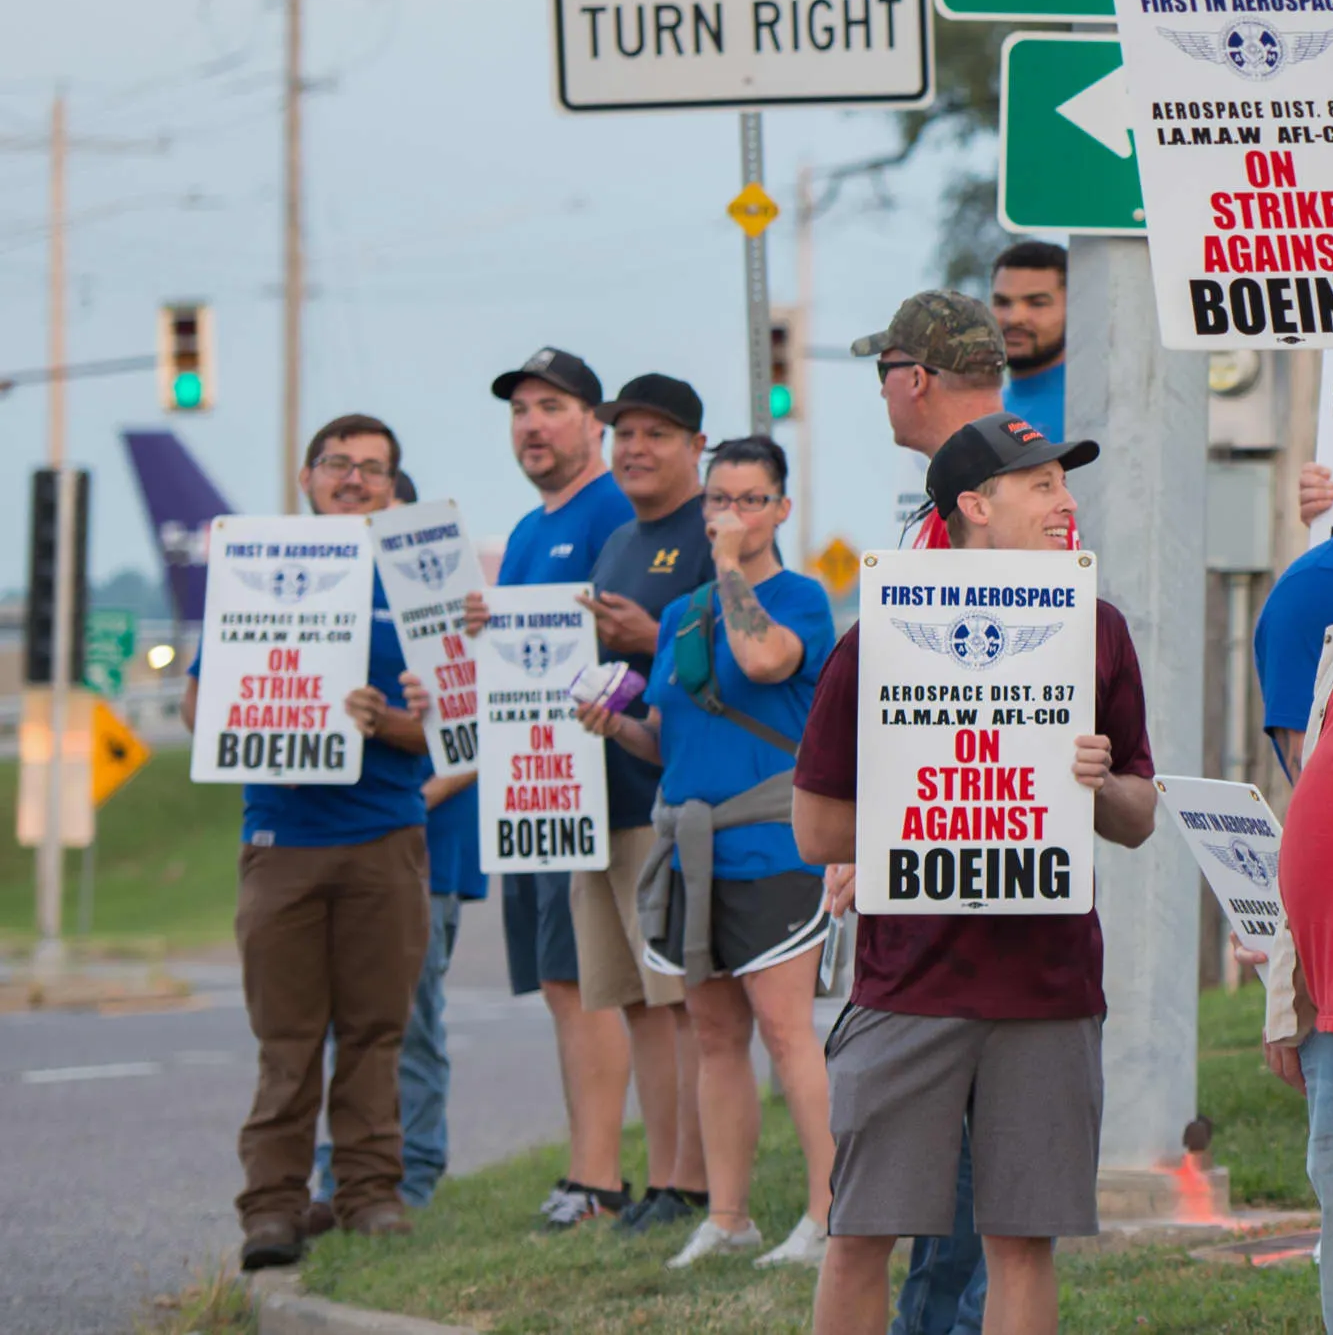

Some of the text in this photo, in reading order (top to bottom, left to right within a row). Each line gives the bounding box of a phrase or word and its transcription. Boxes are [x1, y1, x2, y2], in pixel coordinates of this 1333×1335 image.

[579, 1, 725, 60] TURN
[1152, 101, 1263, 120] AEROSPACE
[1272, 101, 1321, 119] DIST.
[1245, 150, 1296, 188] ON
[225, 544, 359, 559] FIRST IN AEROSPACE
[881, 586, 1075, 607] FIRST IN AEROSPACE
[268, 648, 300, 673] ON
[442, 633, 465, 661] ON
[240, 675, 323, 700] STRIKE
[435, 660, 476, 692] STRI
[438, 690, 477, 721] AGAI
[880, 685, 1074, 701] AEROSPACE DIST. 837
[227, 703, 330, 730] AGAINST
[992, 709, 1070, 725] AFL-CIO
[217, 732, 345, 770] BOEING
[530, 725, 554, 751] ON
[955, 729, 999, 763] ON
[511, 754, 574, 781] STRIKE
[917, 767, 1035, 801] STRIKE
[504, 785, 582, 812] AGAINST
[901, 806, 1048, 841] AGAINST
[1180, 811, 1209, 830] FIRST
[496, 817, 596, 859] BOEING
[888, 847, 1071, 900] BOEING
